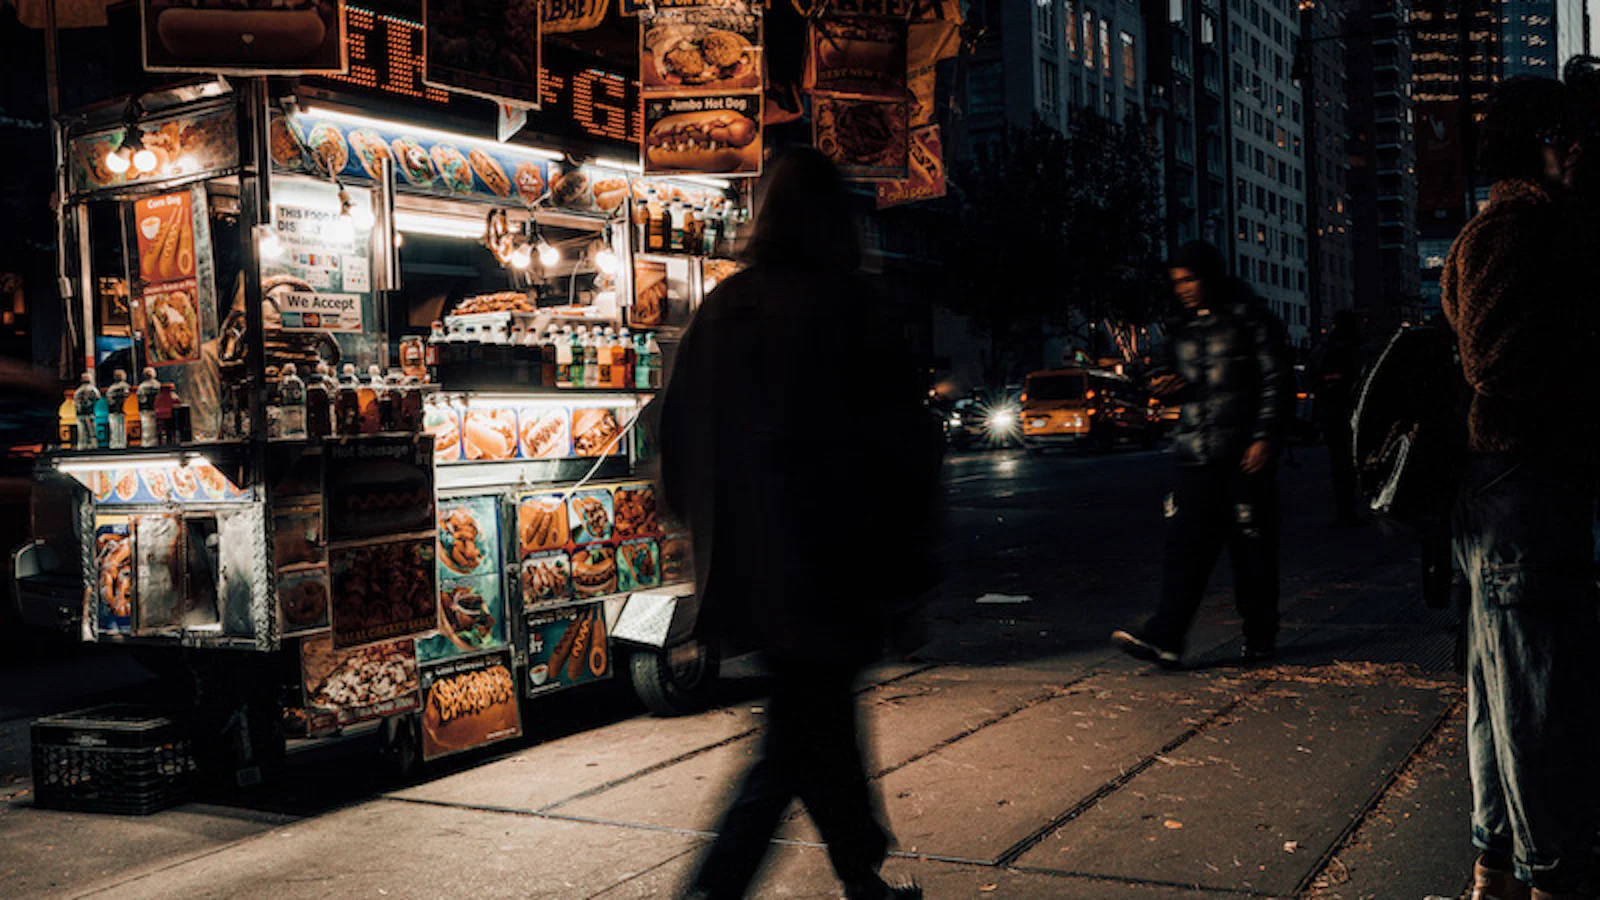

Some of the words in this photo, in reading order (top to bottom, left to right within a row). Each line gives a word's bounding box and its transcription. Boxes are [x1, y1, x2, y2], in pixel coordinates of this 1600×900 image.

[667, 98, 703, 111] Jumbo
[704, 97, 724, 110] Hot
[725, 96, 748, 112] Dog
[147, 198, 165, 210] Corn
[165, 194, 182, 206] Dog
[280, 207, 302, 219] THIS
[287, 295, 309, 308] We
[312, 295, 355, 311] Accept
[331, 445, 354, 459] Hot
[355, 444, 409, 459] Sausage
